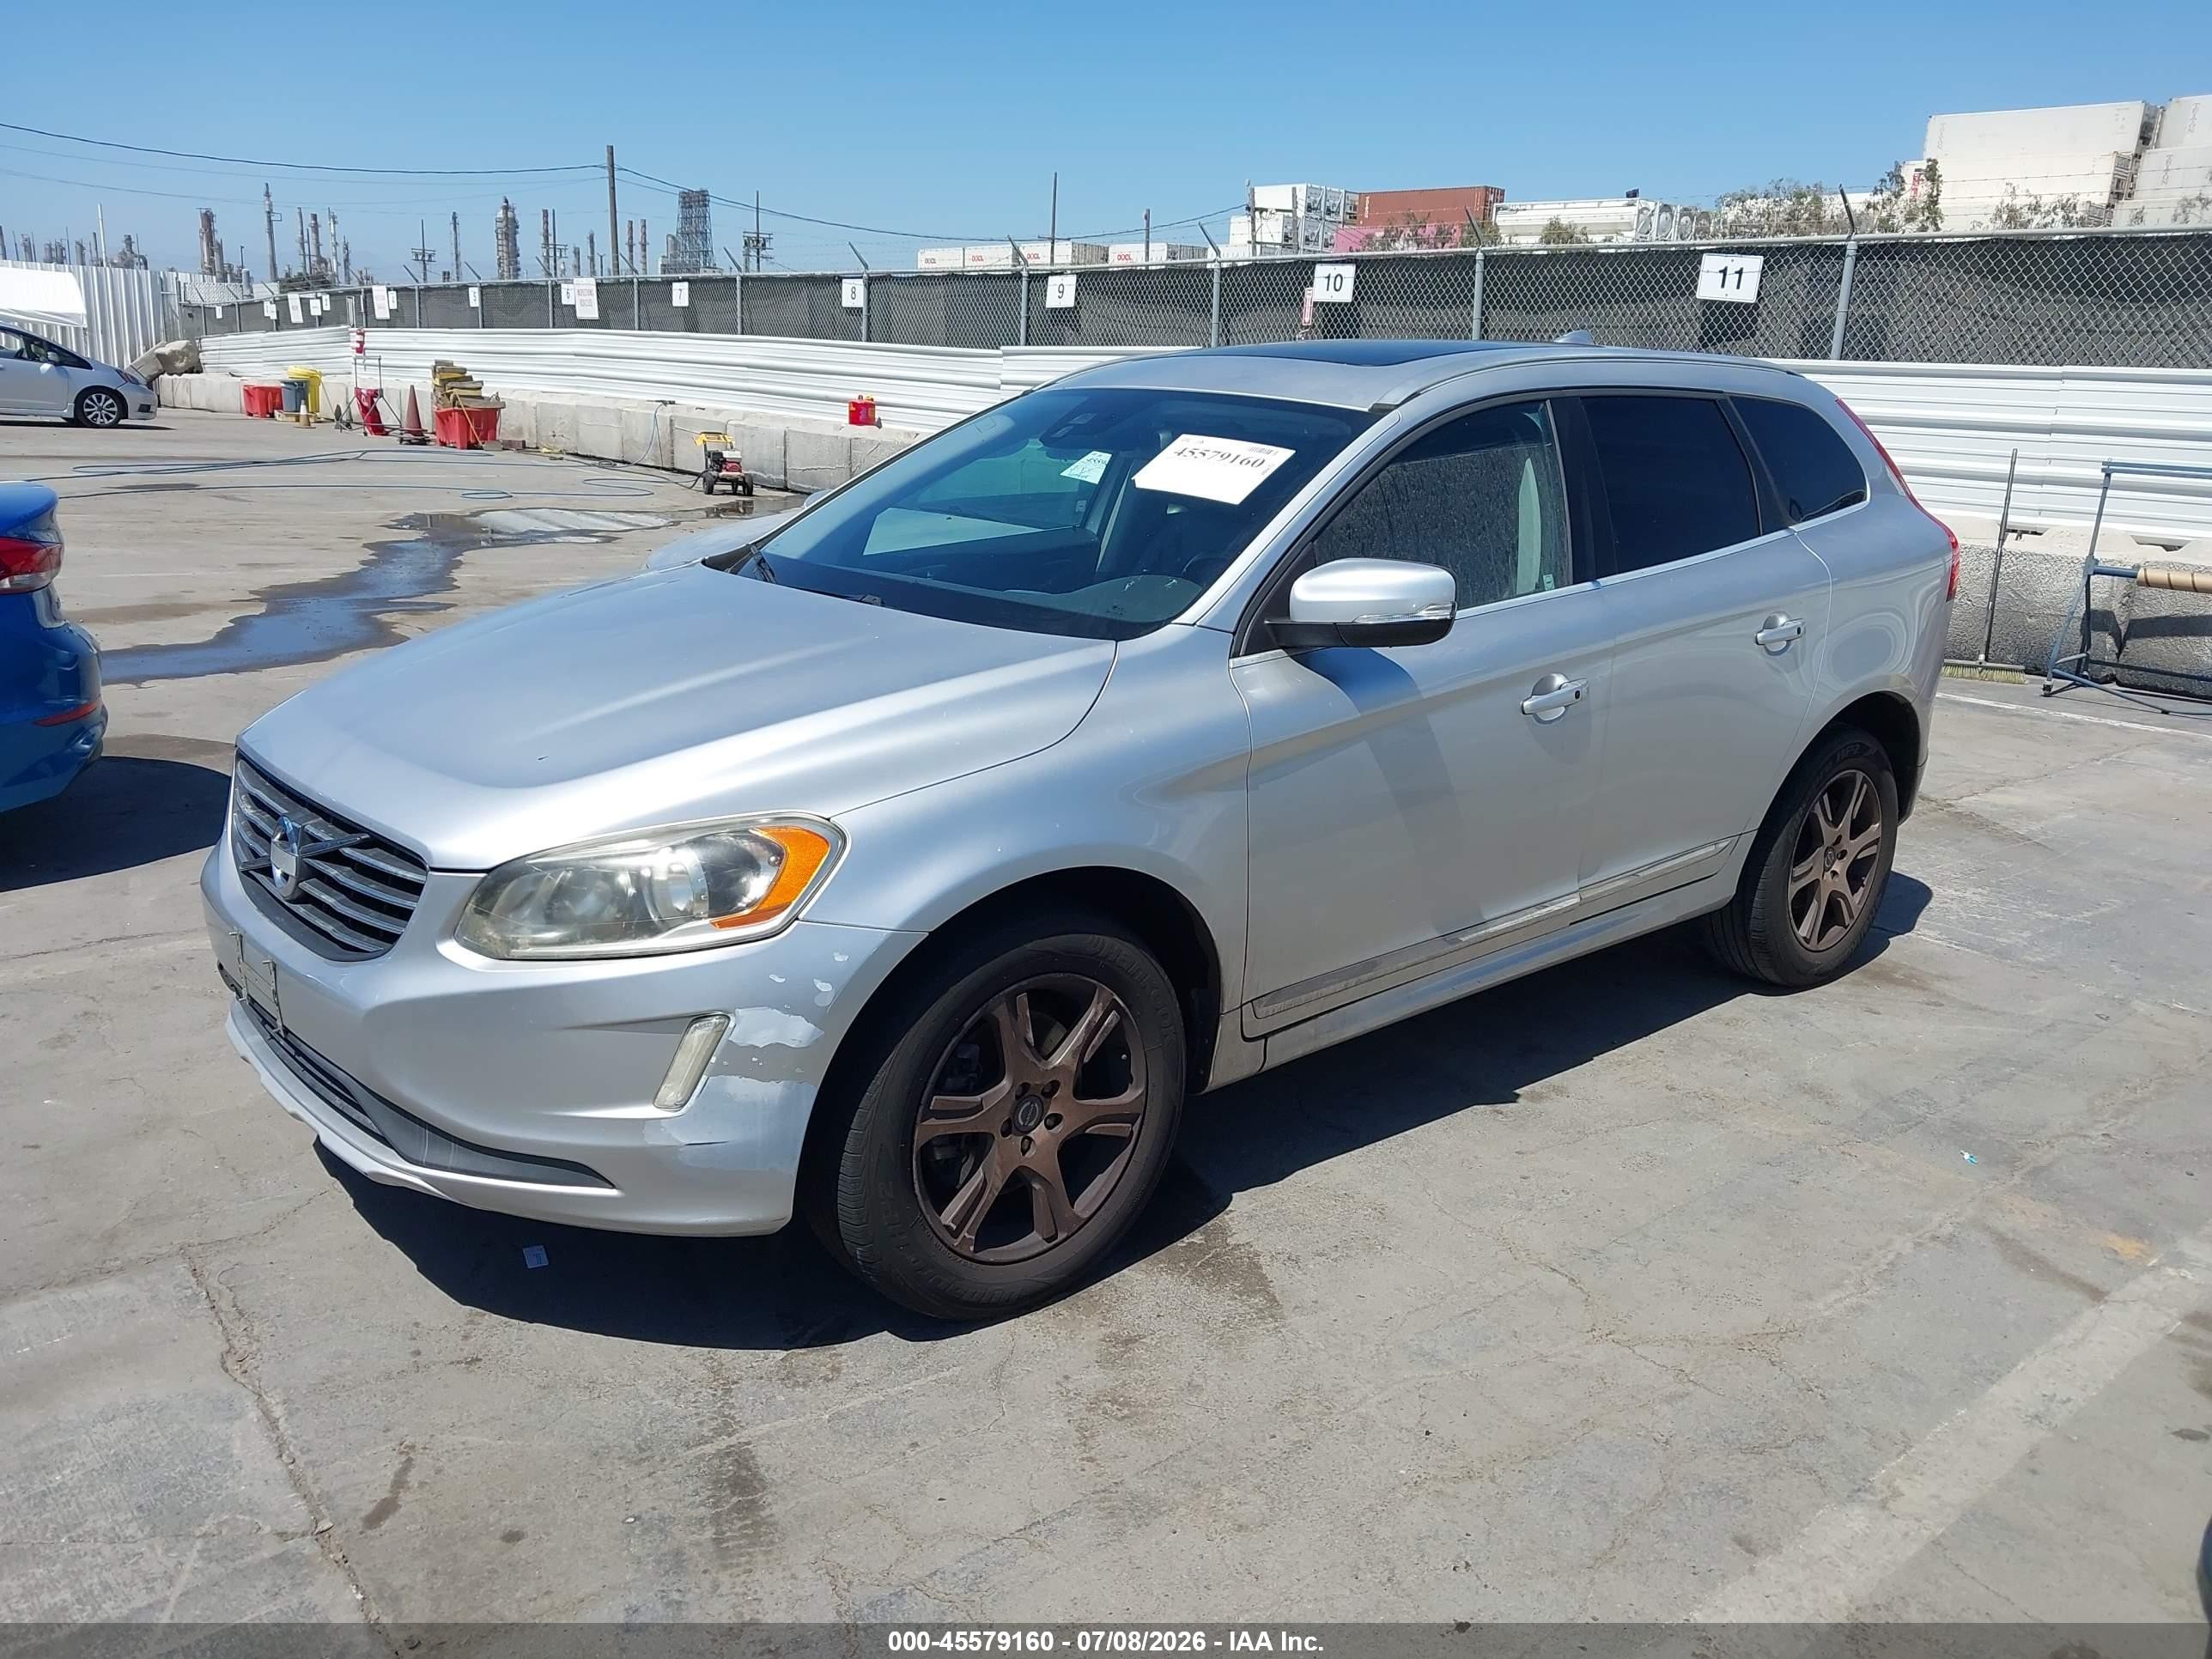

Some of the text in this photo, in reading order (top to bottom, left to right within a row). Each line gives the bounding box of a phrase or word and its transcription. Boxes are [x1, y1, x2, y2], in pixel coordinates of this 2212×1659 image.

[1324, 273, 1344, 292] 10
[1718, 265, 1744, 290] 11
[566, 288, 570, 300] 6
[678, 289, 683, 300] 7
[850, 286, 856, 300] 8
[1057, 283, 1065, 300] 9
[1174, 447, 1267, 468] 45579160
